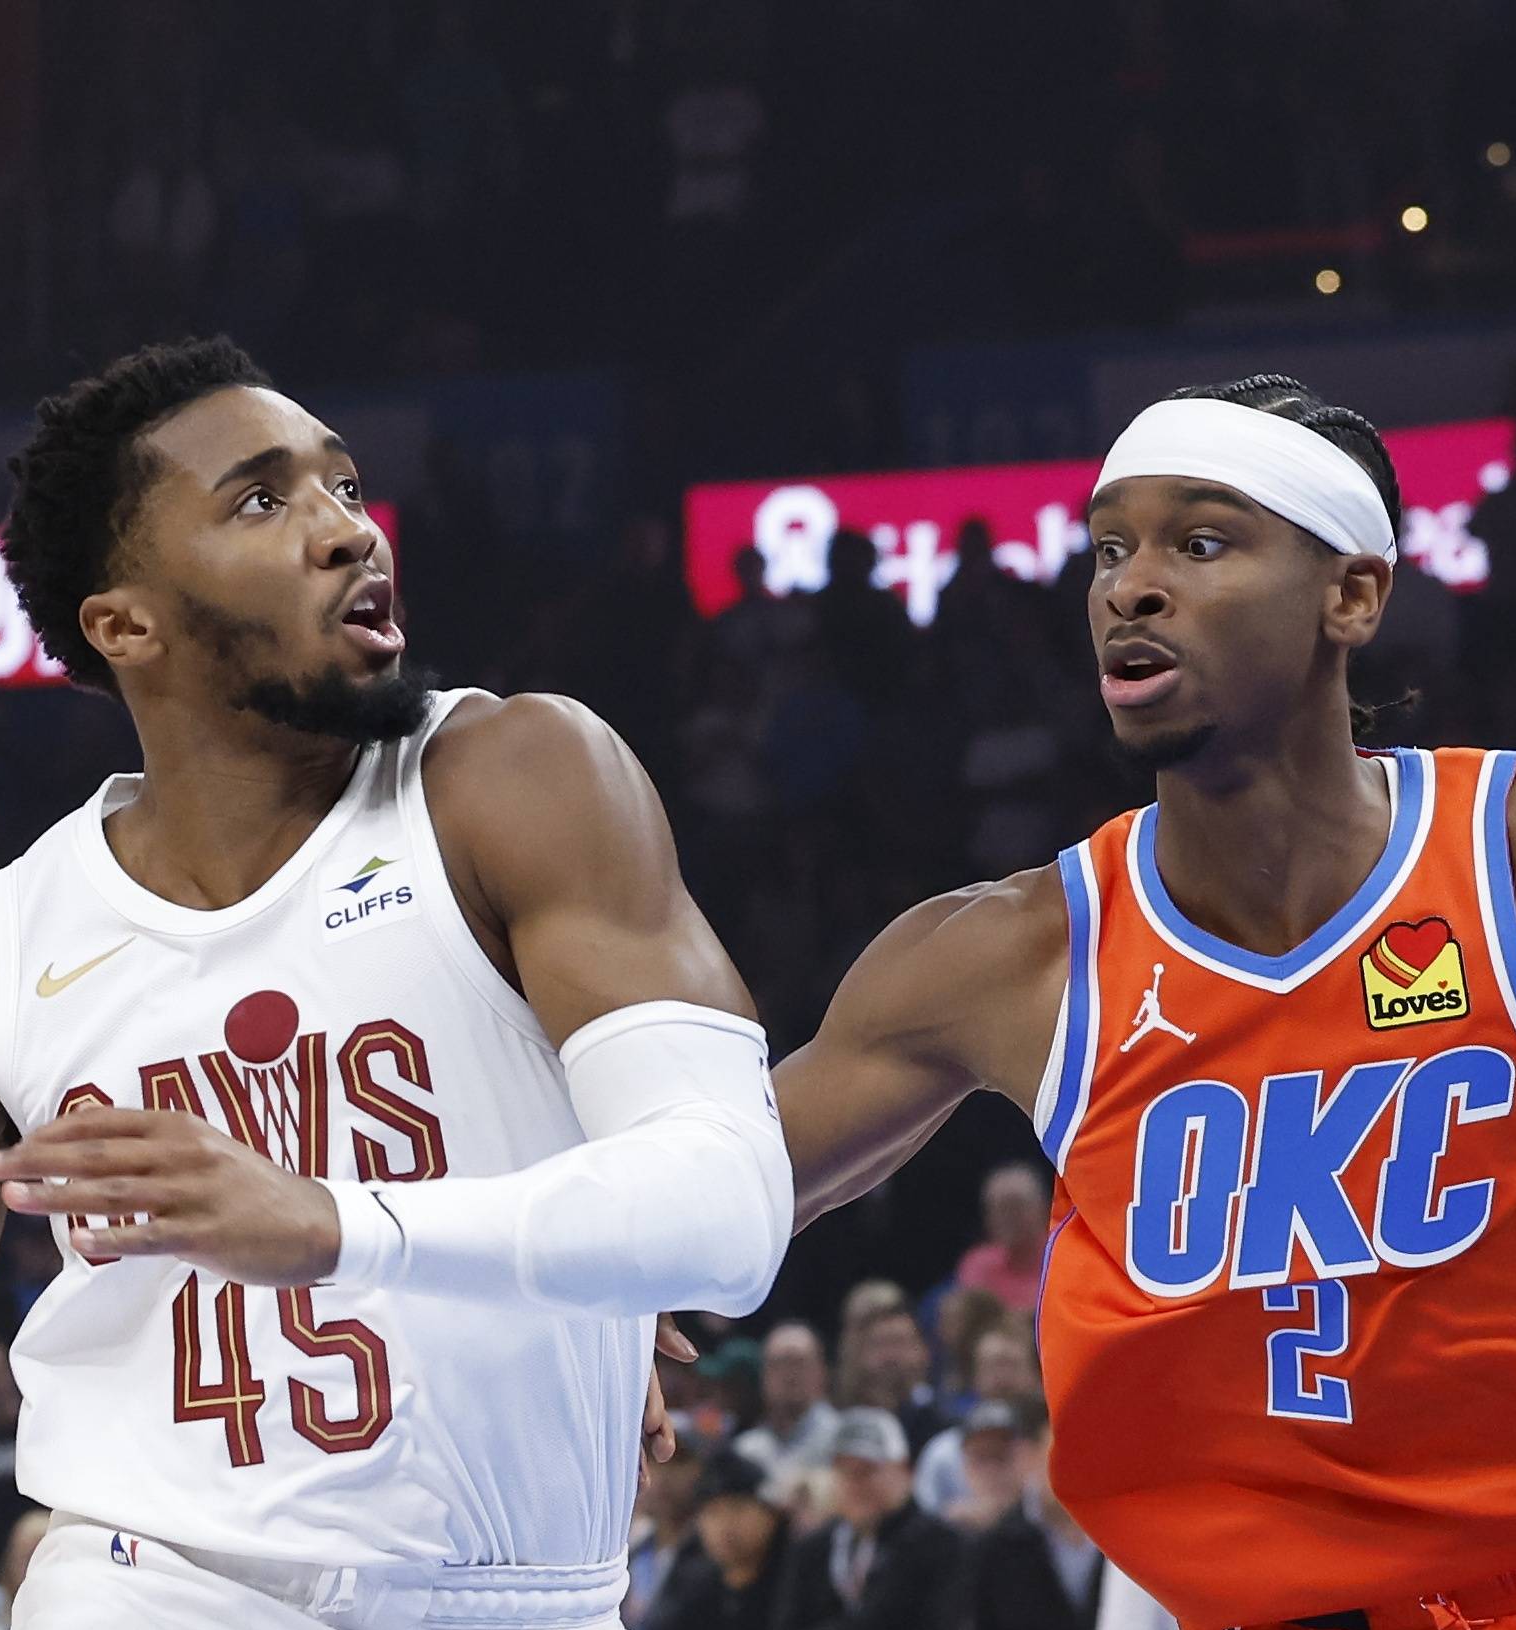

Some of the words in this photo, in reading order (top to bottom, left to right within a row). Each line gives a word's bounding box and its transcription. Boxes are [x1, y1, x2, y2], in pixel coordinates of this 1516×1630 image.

[325, 886, 413, 929] CLIFFS
[1125, 1045, 1516, 1298] OKC
[172, 1268, 394, 1468] 45
[1262, 1278, 1354, 1425] 2
